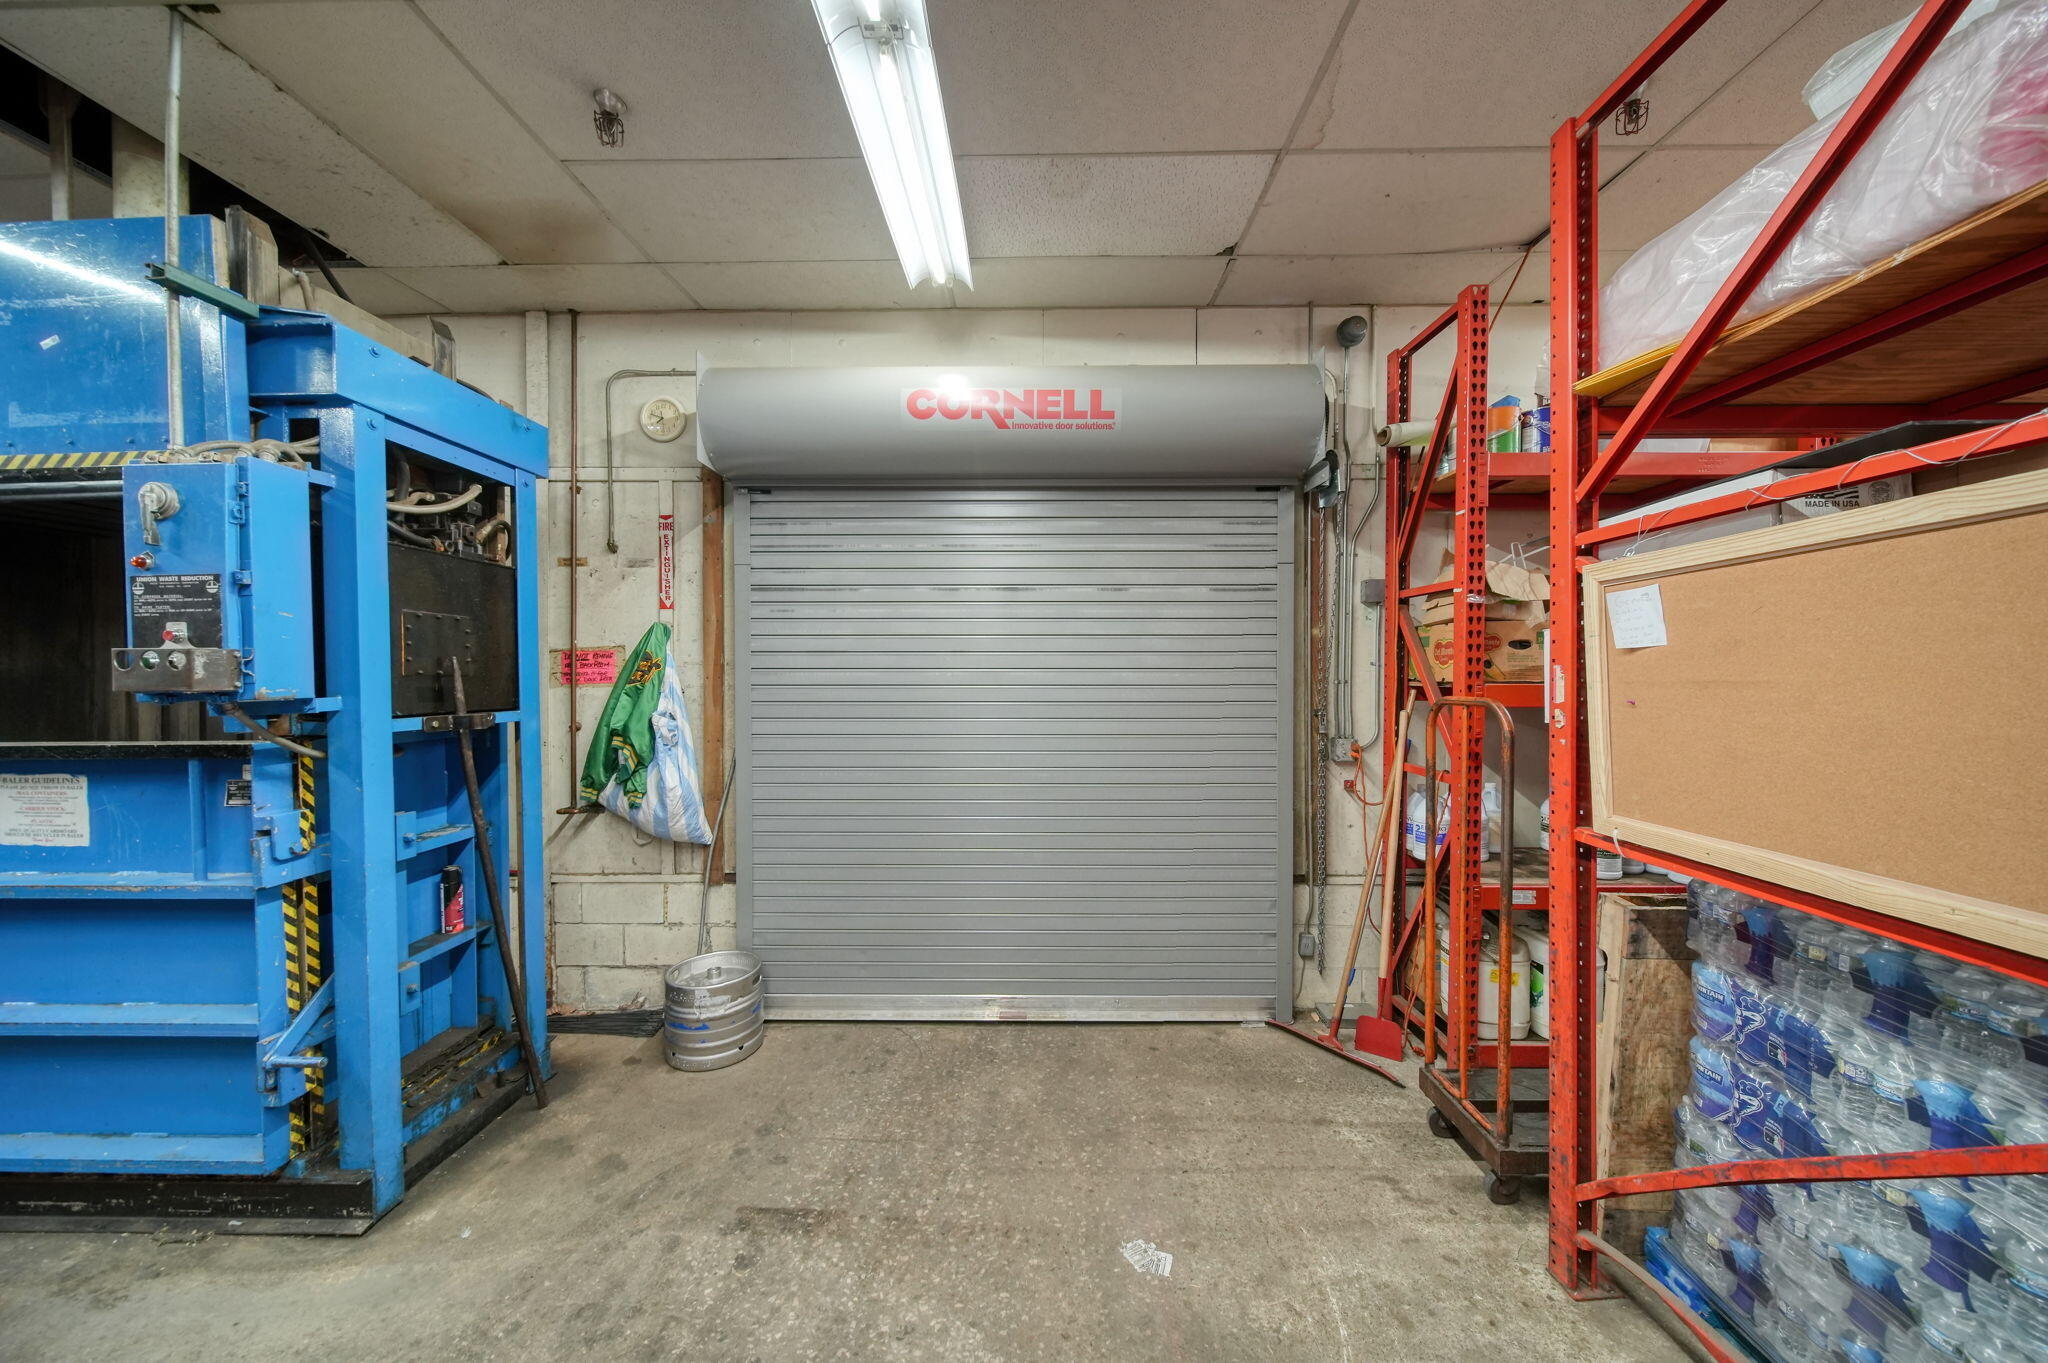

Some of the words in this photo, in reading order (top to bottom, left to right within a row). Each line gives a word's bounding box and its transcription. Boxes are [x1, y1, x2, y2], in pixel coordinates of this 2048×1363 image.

[907, 388, 1115, 430] CORNELL
[1012, 421, 1054, 430] Innovative
[1055, 421, 1073, 430] door
[1804, 500, 1830, 508] MADE
[1831, 500, 1840, 508] IN
[1842, 500, 1860, 508] USA
[659, 522, 674, 531] FIRE
[663, 534, 671, 601] EXTINGUISHER
